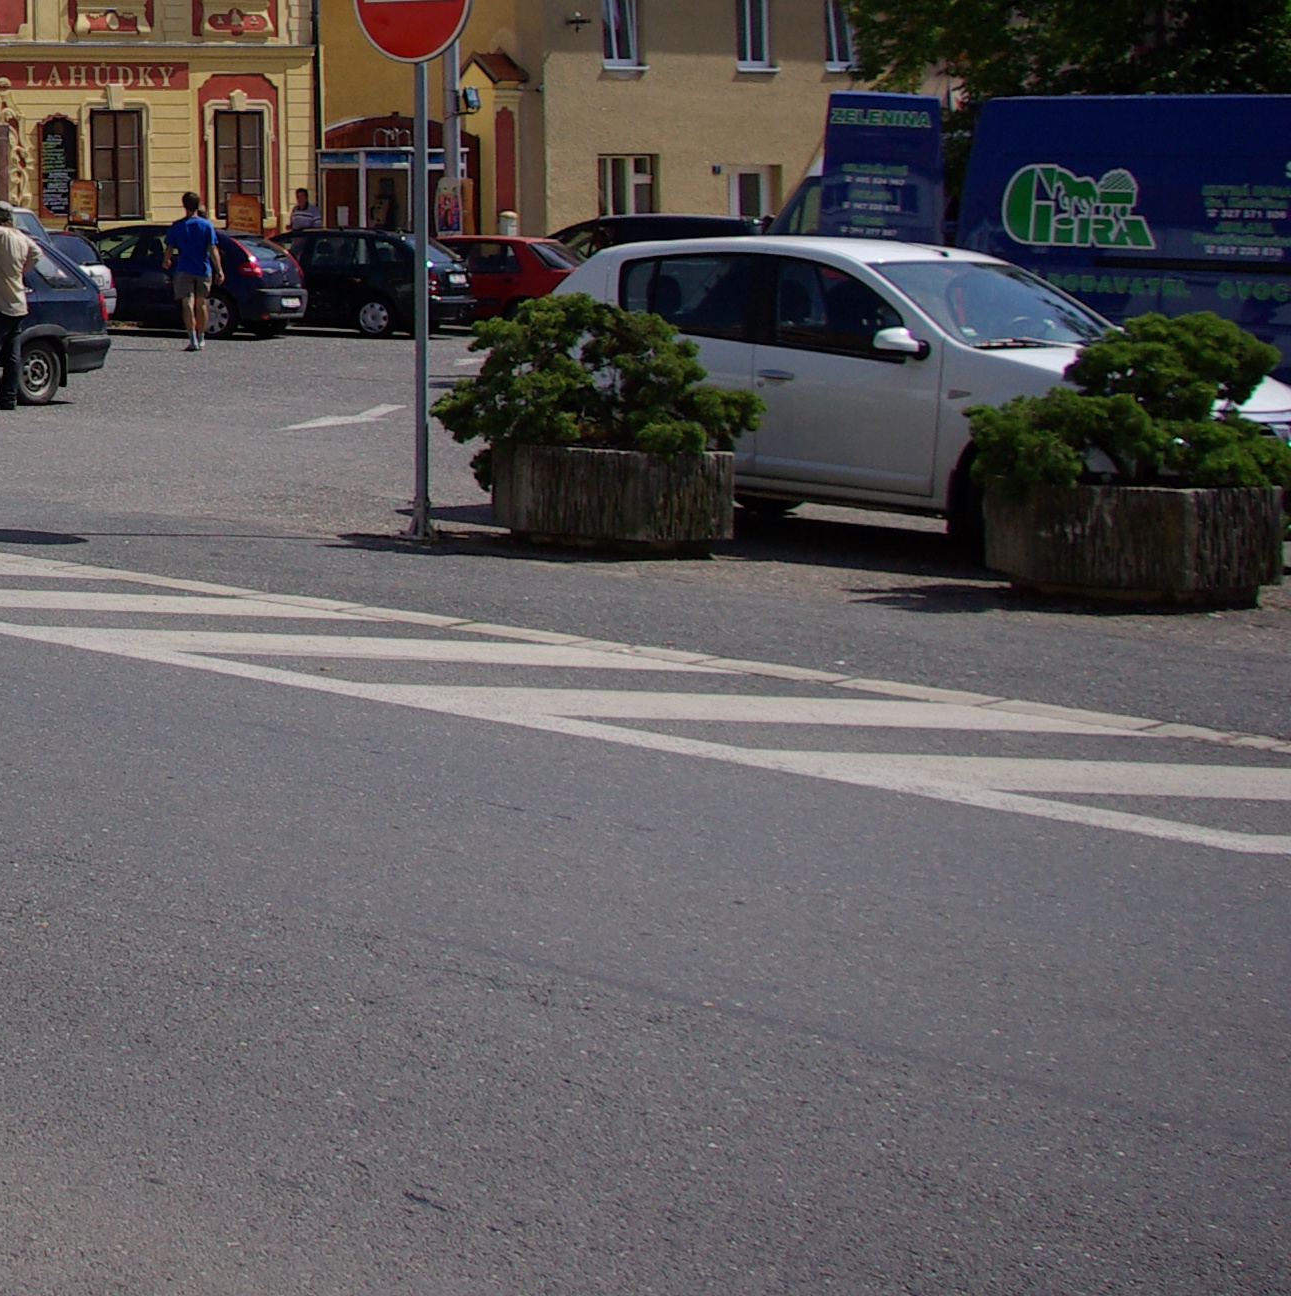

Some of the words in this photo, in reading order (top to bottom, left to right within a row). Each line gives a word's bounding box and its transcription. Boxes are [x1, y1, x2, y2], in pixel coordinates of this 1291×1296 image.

[26, 61, 176, 88] LAHŮDKY
[830, 107, 933, 128] ZELENINA
[1046, 273, 1191, 298] DODAVATEL
